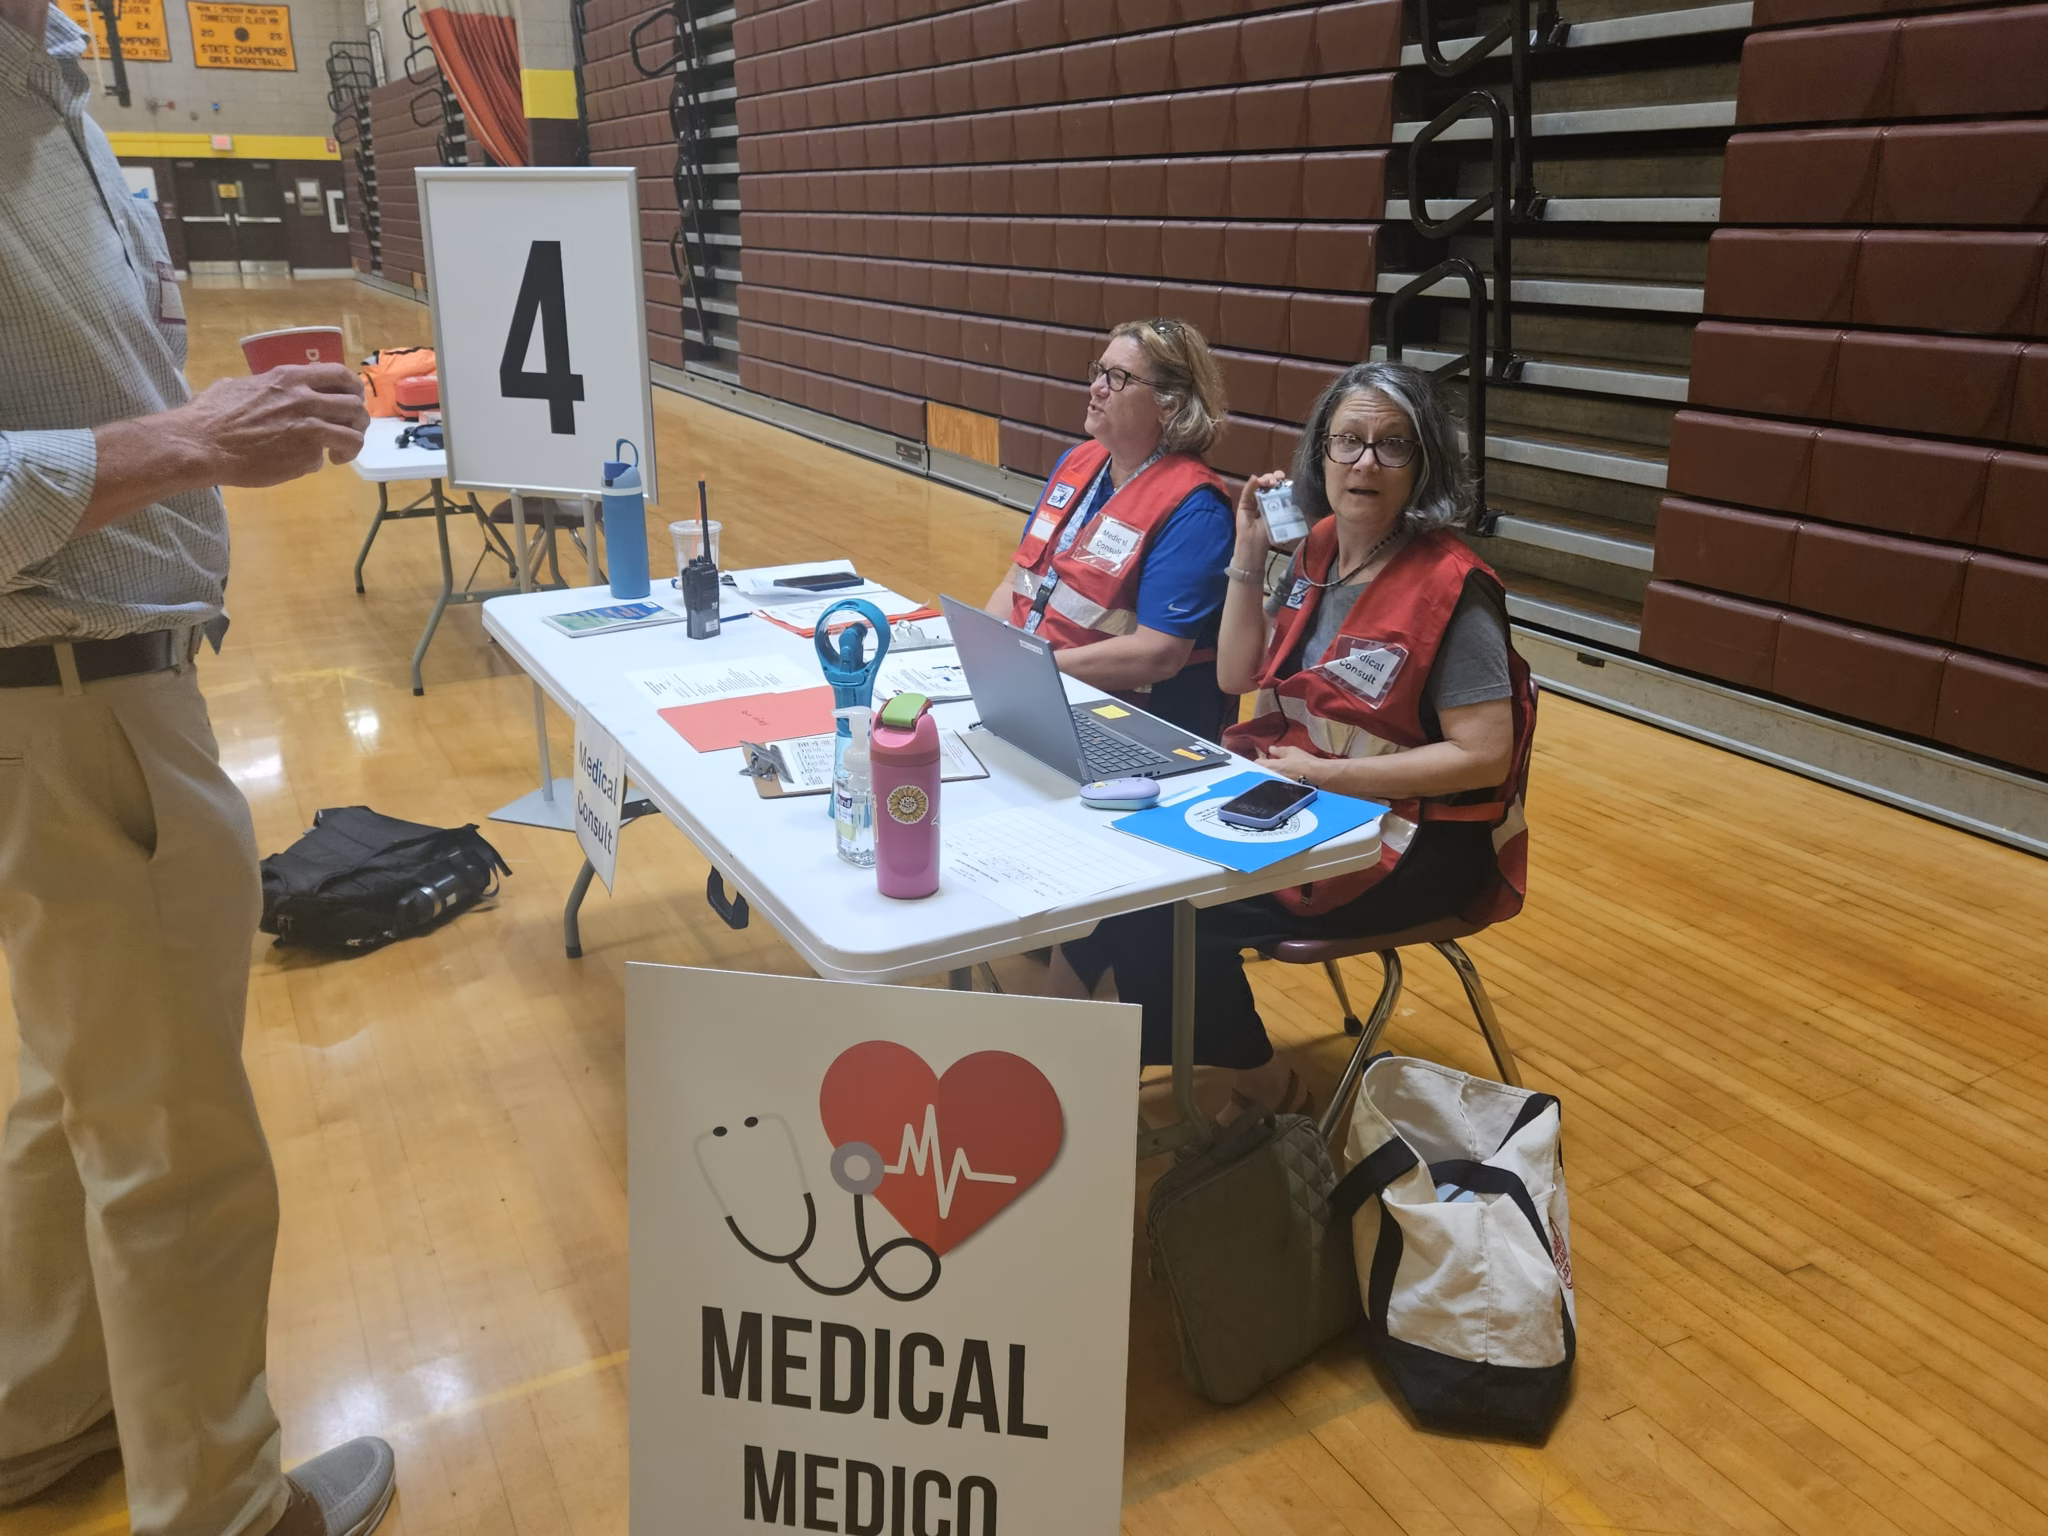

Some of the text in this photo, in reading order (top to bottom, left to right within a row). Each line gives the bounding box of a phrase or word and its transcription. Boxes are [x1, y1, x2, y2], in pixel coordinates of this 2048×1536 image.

[201, 44, 287, 57] STATE CHAMPIONS
[233, 57, 282, 67] BASKETBALL
[499, 240, 586, 436] 4
[1096, 540, 1122, 557] Consult
[1339, 658, 1377, 685] Consult
[579, 740, 618, 806] Medical
[577, 789, 613, 855] Consult
[701, 1305, 1049, 1440] MEDICAL
[743, 1444, 998, 1536] MEDICO
